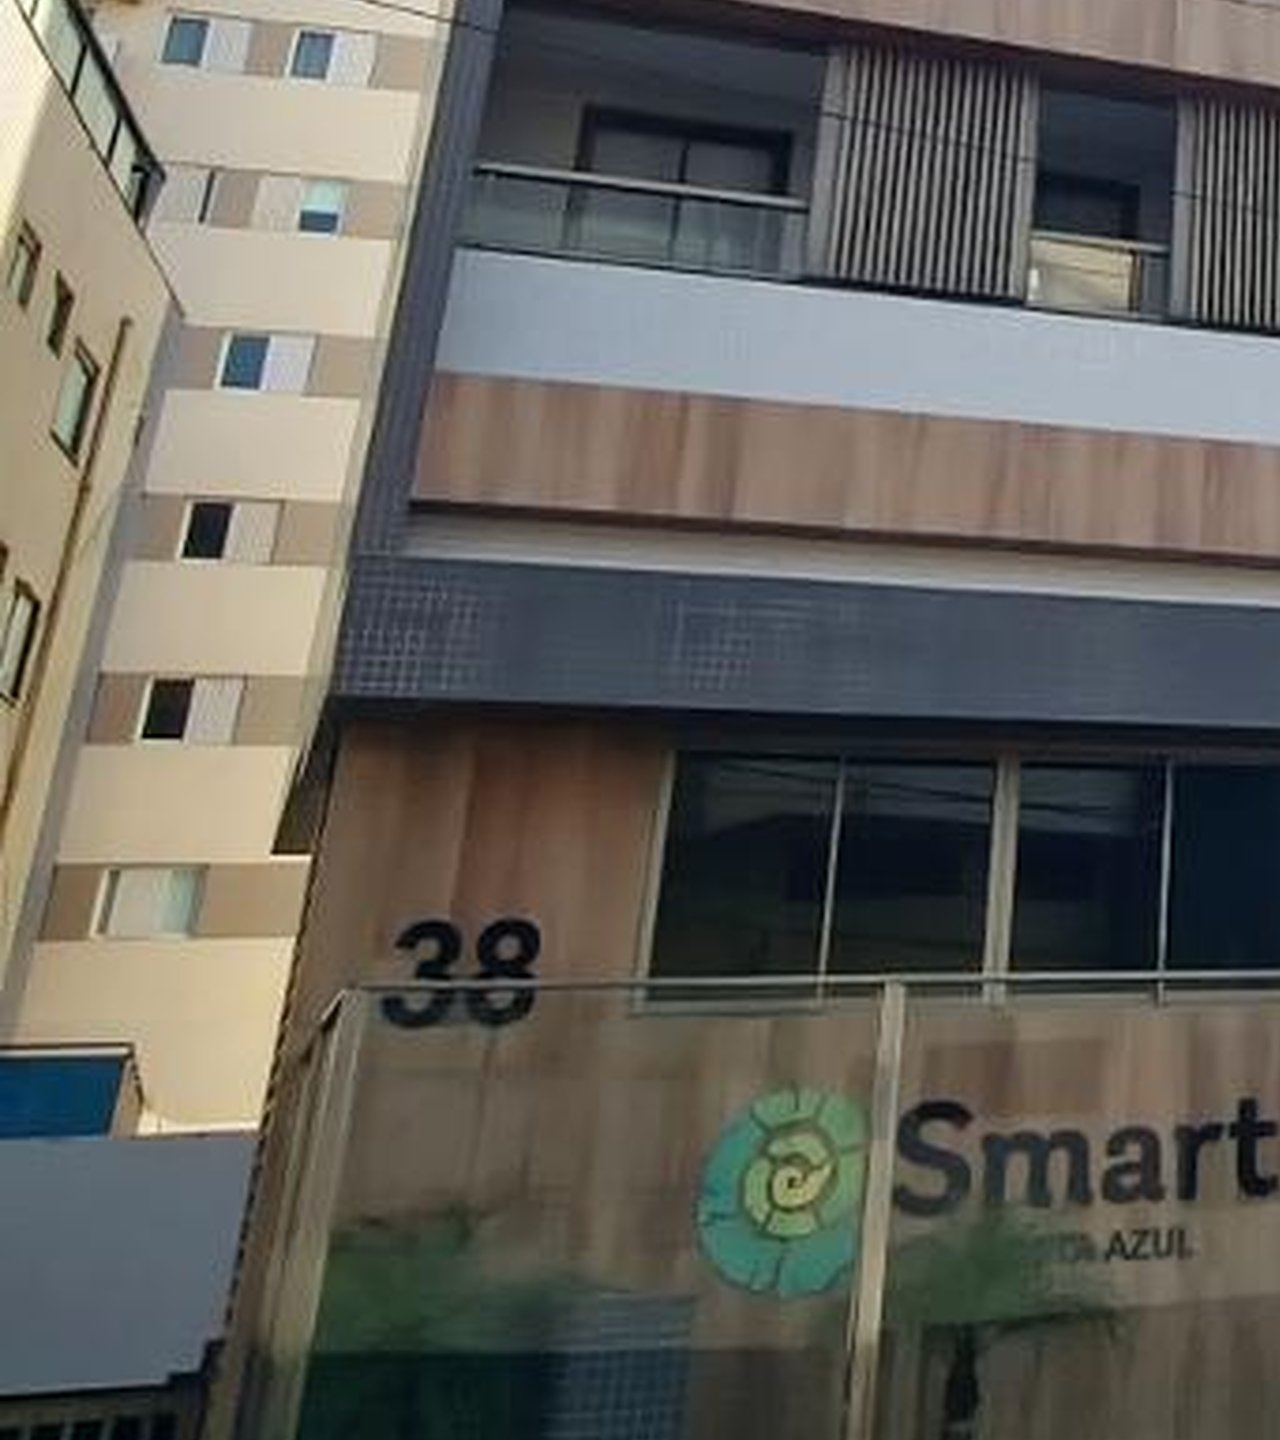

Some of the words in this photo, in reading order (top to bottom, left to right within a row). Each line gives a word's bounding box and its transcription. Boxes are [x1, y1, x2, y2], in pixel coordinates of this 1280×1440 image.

[380, 919, 542, 1029] 38
[896, 1097, 1279, 1216] Smart
[1104, 1228, 1194, 1261] AZUL
